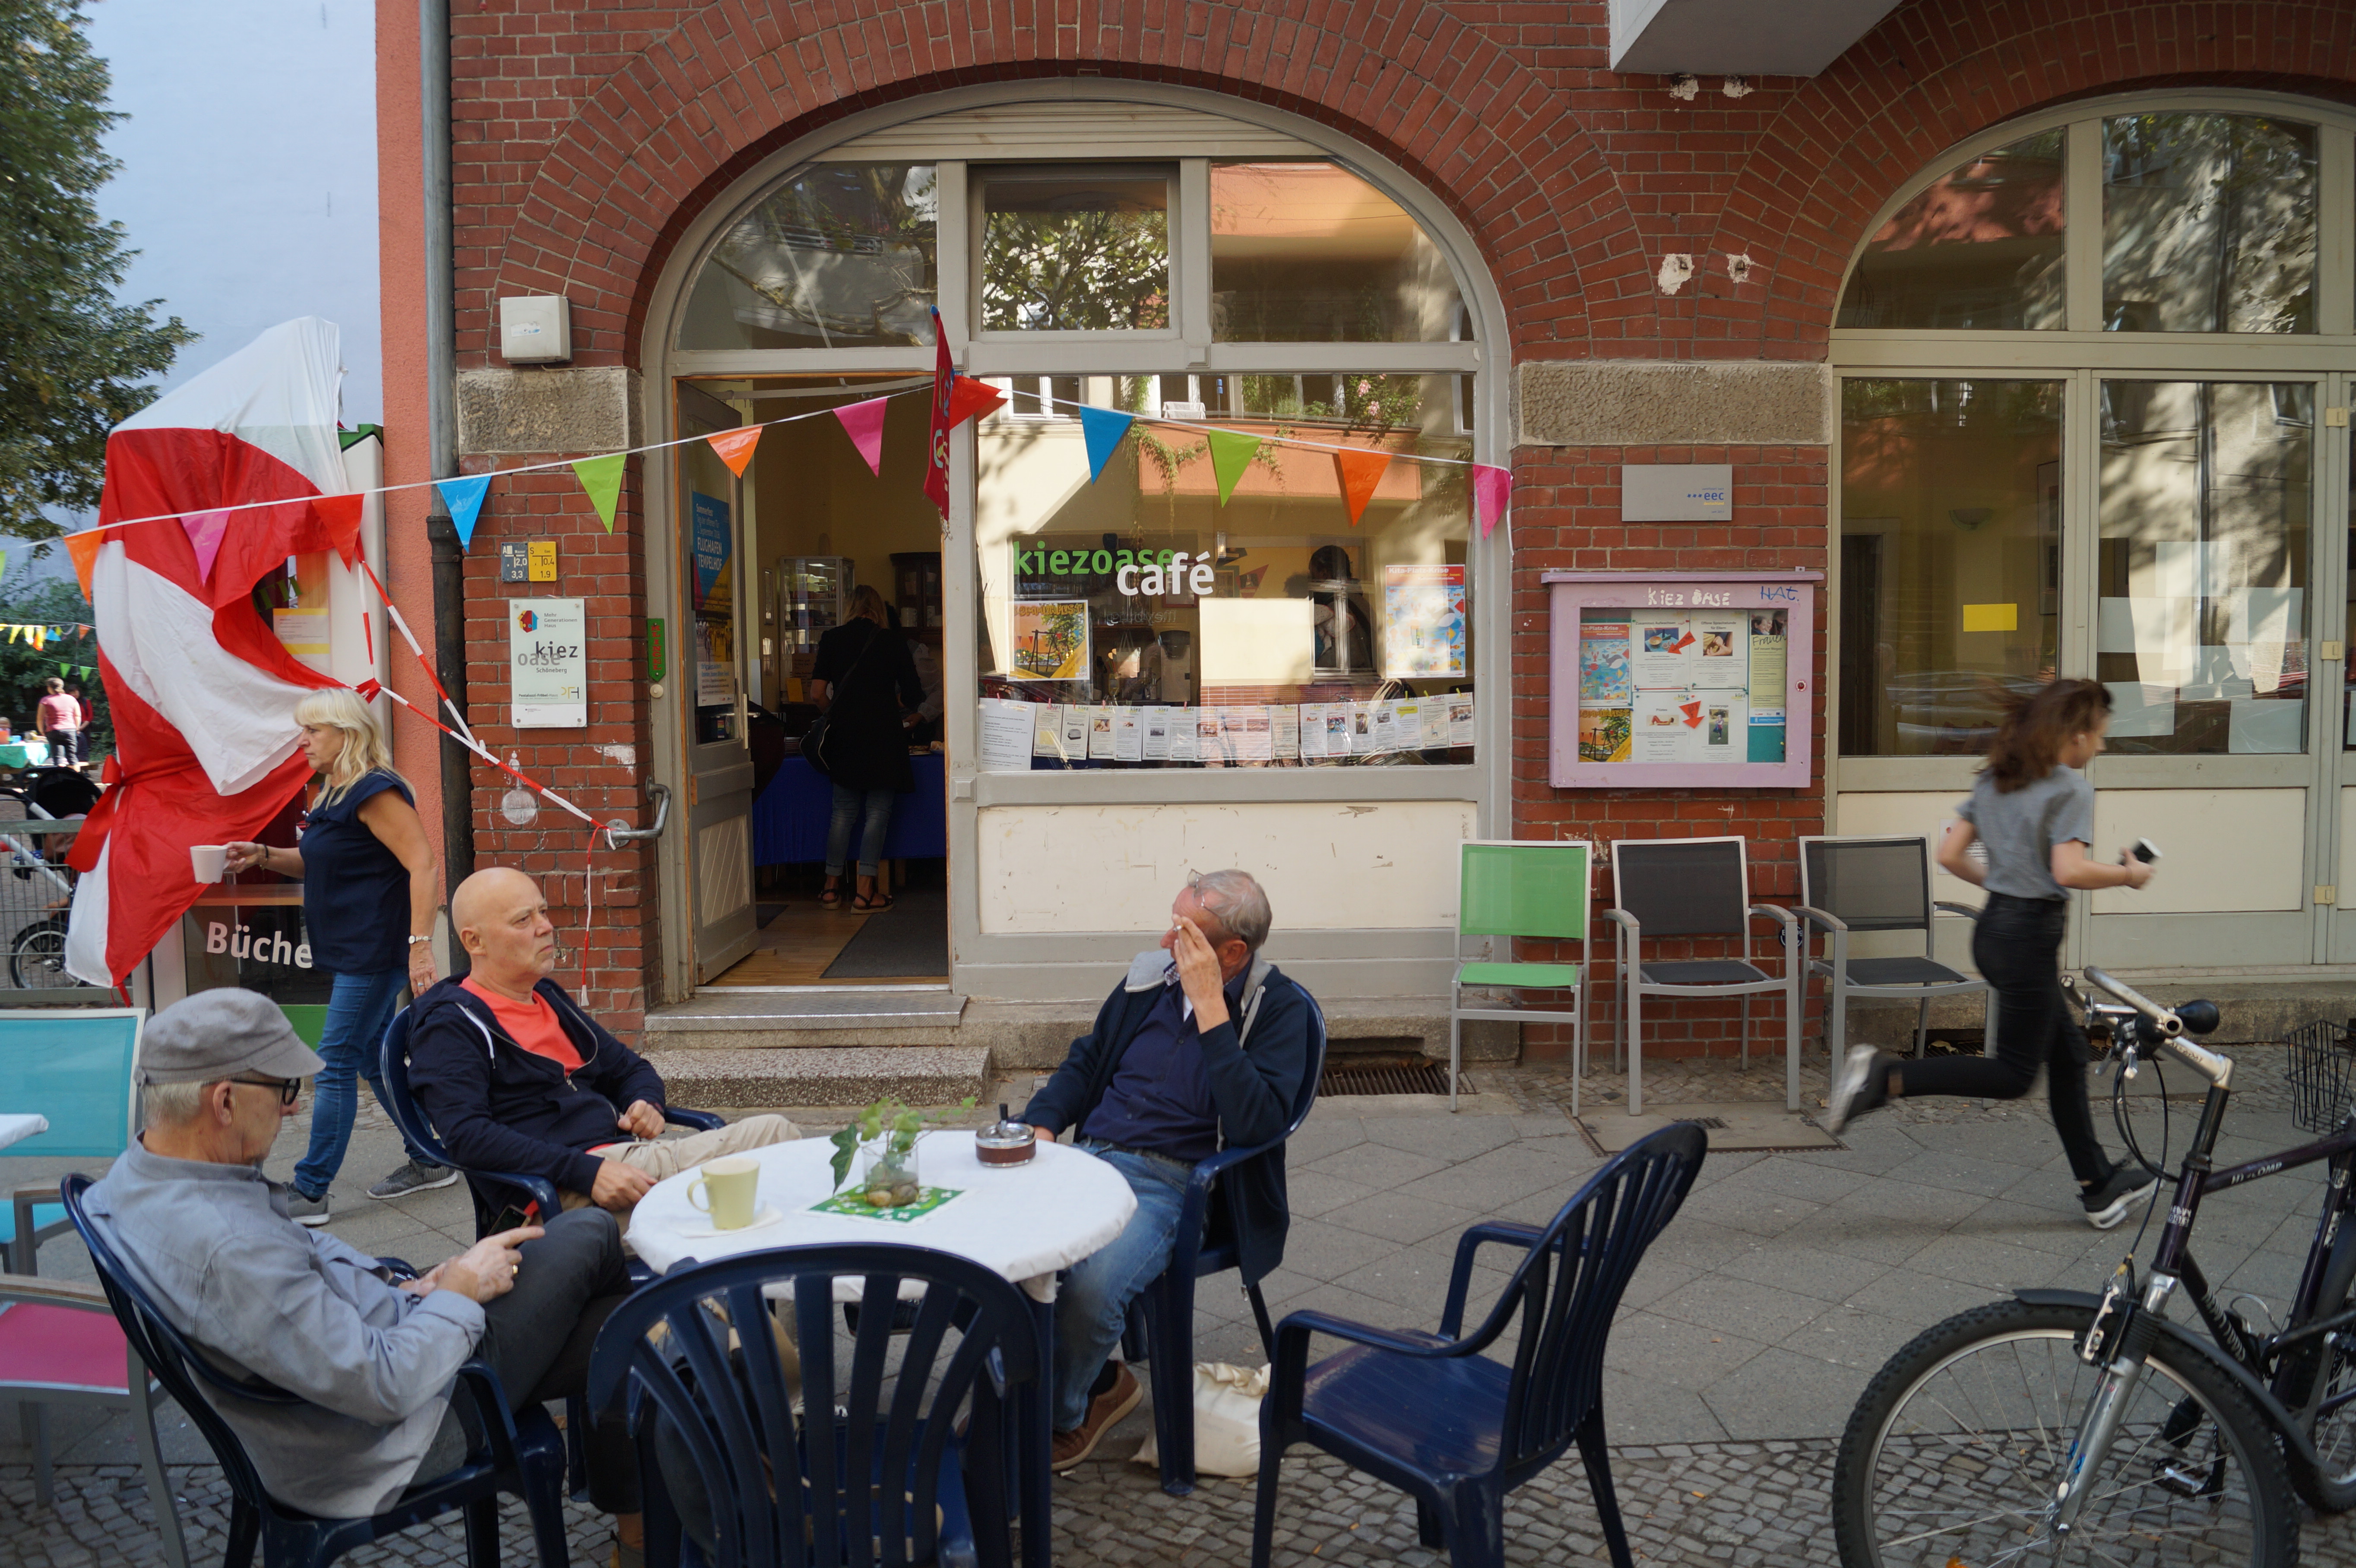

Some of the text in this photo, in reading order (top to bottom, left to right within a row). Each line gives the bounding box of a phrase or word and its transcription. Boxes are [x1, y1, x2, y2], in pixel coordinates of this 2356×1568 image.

[1704, 492, 1724, 500] eec
[697, 537, 722, 555] FLUGHAFEN
[516, 558, 527, 566] 2,0
[698, 554, 722, 571] TEMPELHOF
[1013, 541, 1175, 575] kiezoase
[512, 571, 523, 579] 3,3
[1117, 551, 1214, 596] café
[651, 625, 662, 670] KLINGEL
[1752, 634, 1787, 646] Frauen
[535, 641, 578, 658] kiez
[518, 653, 560, 666] oase
[206, 921, 313, 969] Büche
